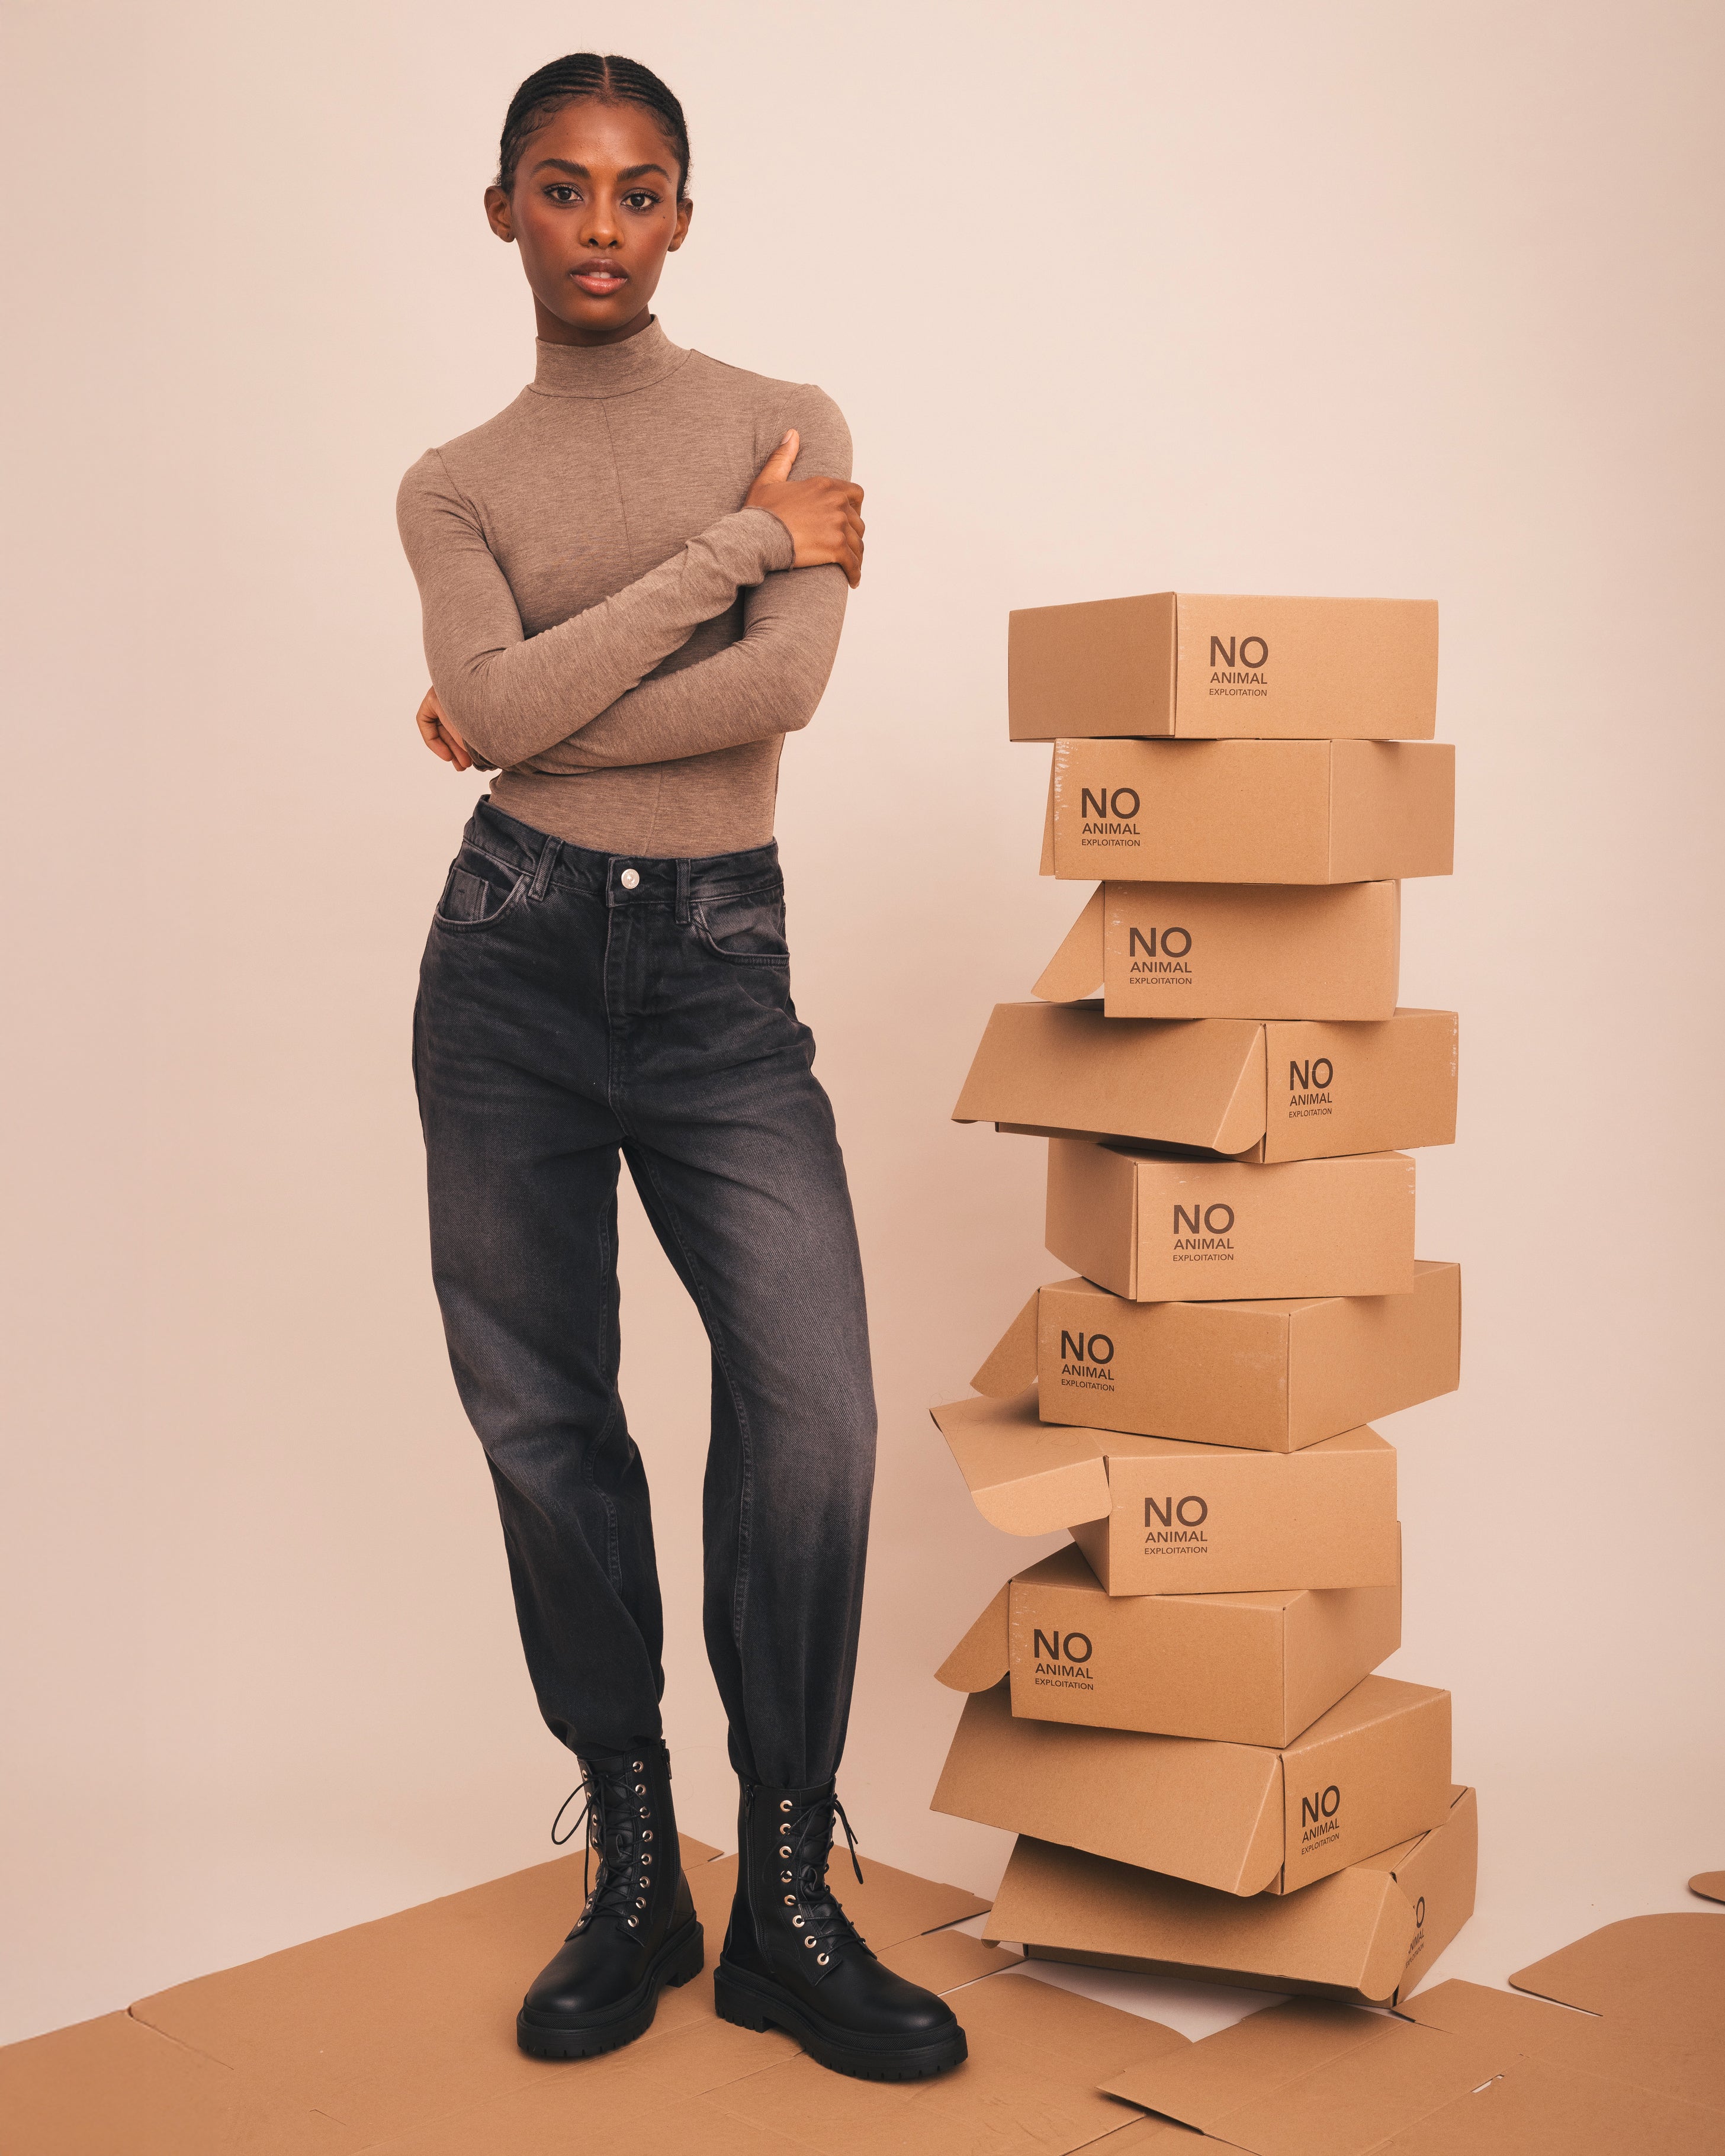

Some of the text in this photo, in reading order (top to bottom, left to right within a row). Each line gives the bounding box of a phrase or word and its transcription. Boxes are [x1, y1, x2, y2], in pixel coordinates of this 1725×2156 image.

[1210, 635, 1268, 669] NO
[1210, 671, 1268, 685] ANIMAL
[1209, 687, 1267, 696] EXPLOITATION
[1081, 788, 1141, 820] NO
[1081, 822, 1141, 835] ANIMAL
[1081, 838, 1141, 847] EXPLOITATION
[1129, 927, 1192, 958] NO
[1129, 961, 1193, 973] ANIMAL
[1129, 976, 1192, 985] EXPLOITATION
[1289, 1058, 1334, 1091] NO
[1289, 1092, 1333, 1107] ANIMAL
[1289, 1108, 1332, 1119] EXPLOITATION
[1173, 1203, 1235, 1235] NO
[1173, 1238, 1235, 1251] ANIMAL
[1173, 1254, 1234, 1262] EXPLOITATION
[1061, 1329, 1114, 1365] NO
[1061, 1364, 1115, 1381] ANIMAL
[1061, 1378, 1114, 1392] EXPLOITATION
[1144, 1495, 1208, 1528] NO
[1144, 1530, 1208, 1544] ANIMAL
[1143, 1546, 1208, 1555] EXPLOITATION
[1033, 1628, 1093, 1664] NO
[1035, 1662, 1094, 1680] ANIMAL
[1035, 1676, 1094, 1691] EXPLOITATION
[1302, 1785, 1341, 1829] NO
[1302, 1817, 1340, 1844] ANIMAL
[1301, 1832, 1339, 1855] EXPLOITATION
[1413, 1896, 1425, 1930] O
